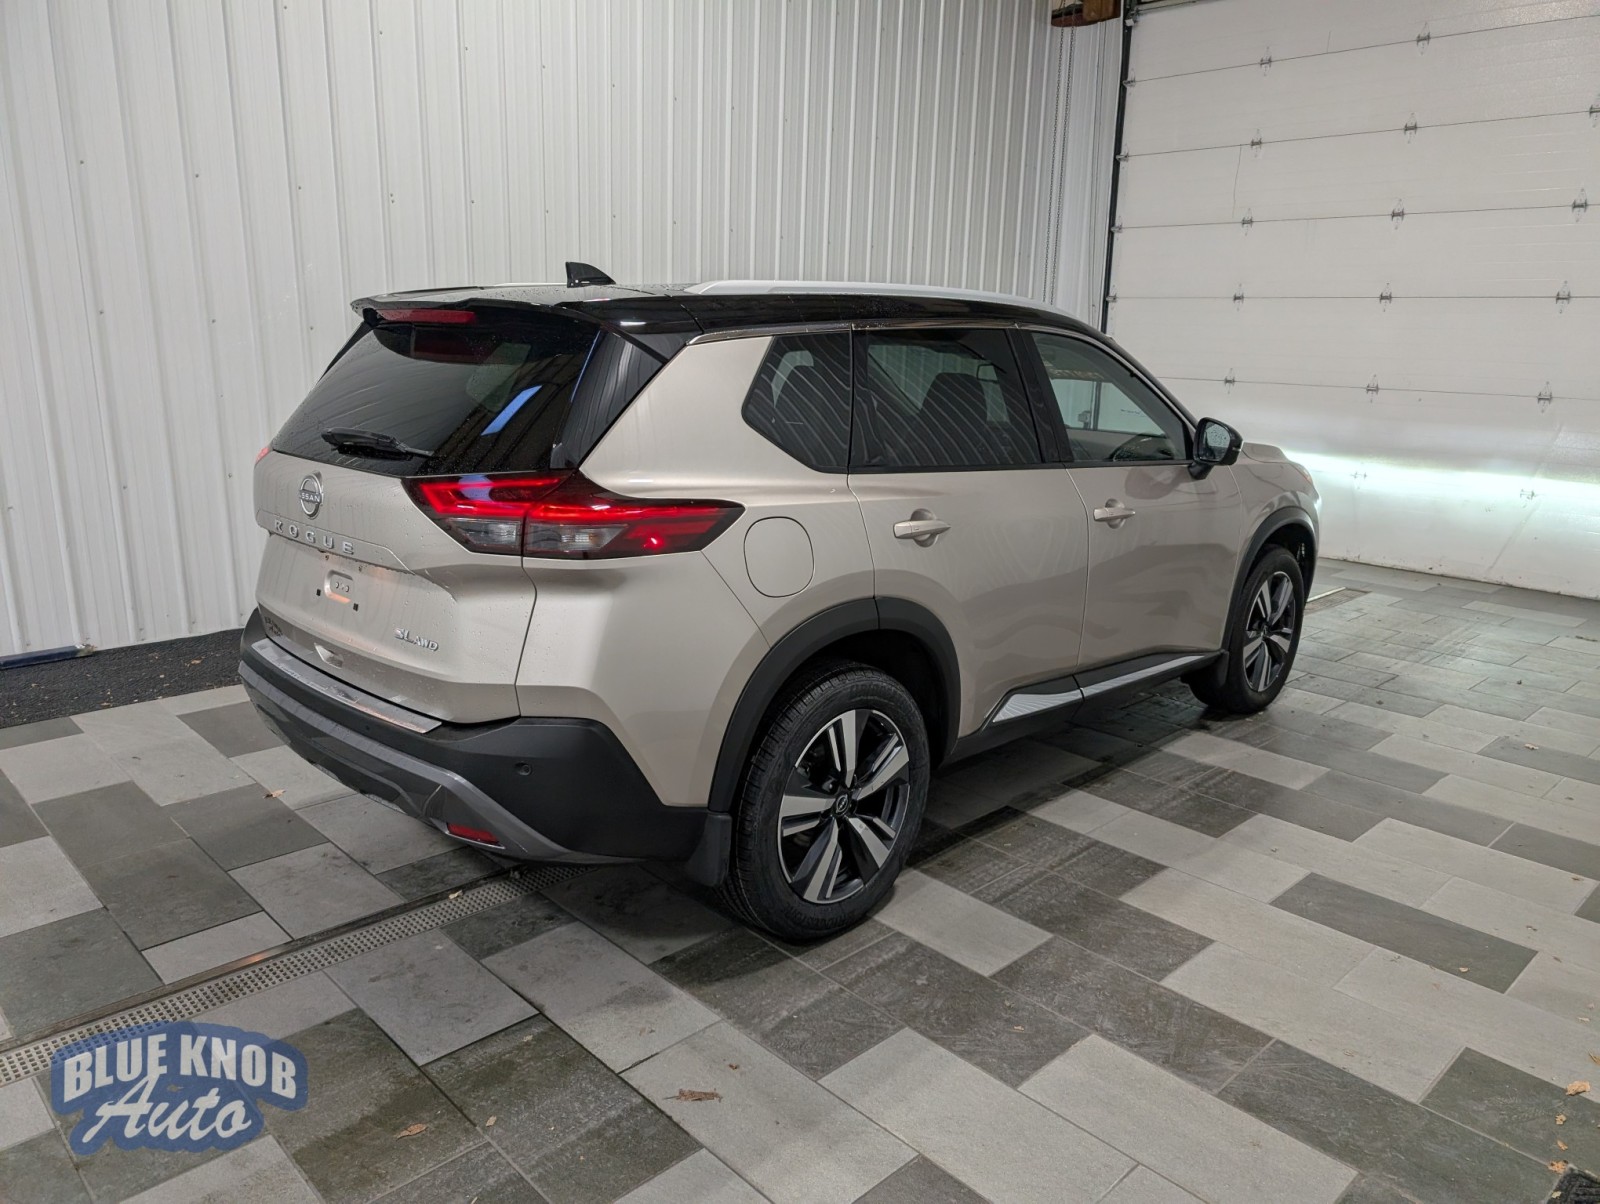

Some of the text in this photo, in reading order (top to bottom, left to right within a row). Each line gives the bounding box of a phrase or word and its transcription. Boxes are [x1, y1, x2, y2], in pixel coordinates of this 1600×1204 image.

[300, 492, 321, 503] SSAN
[274, 519, 354, 555] ROGUE
[394, 628, 439, 651] SL AWD
